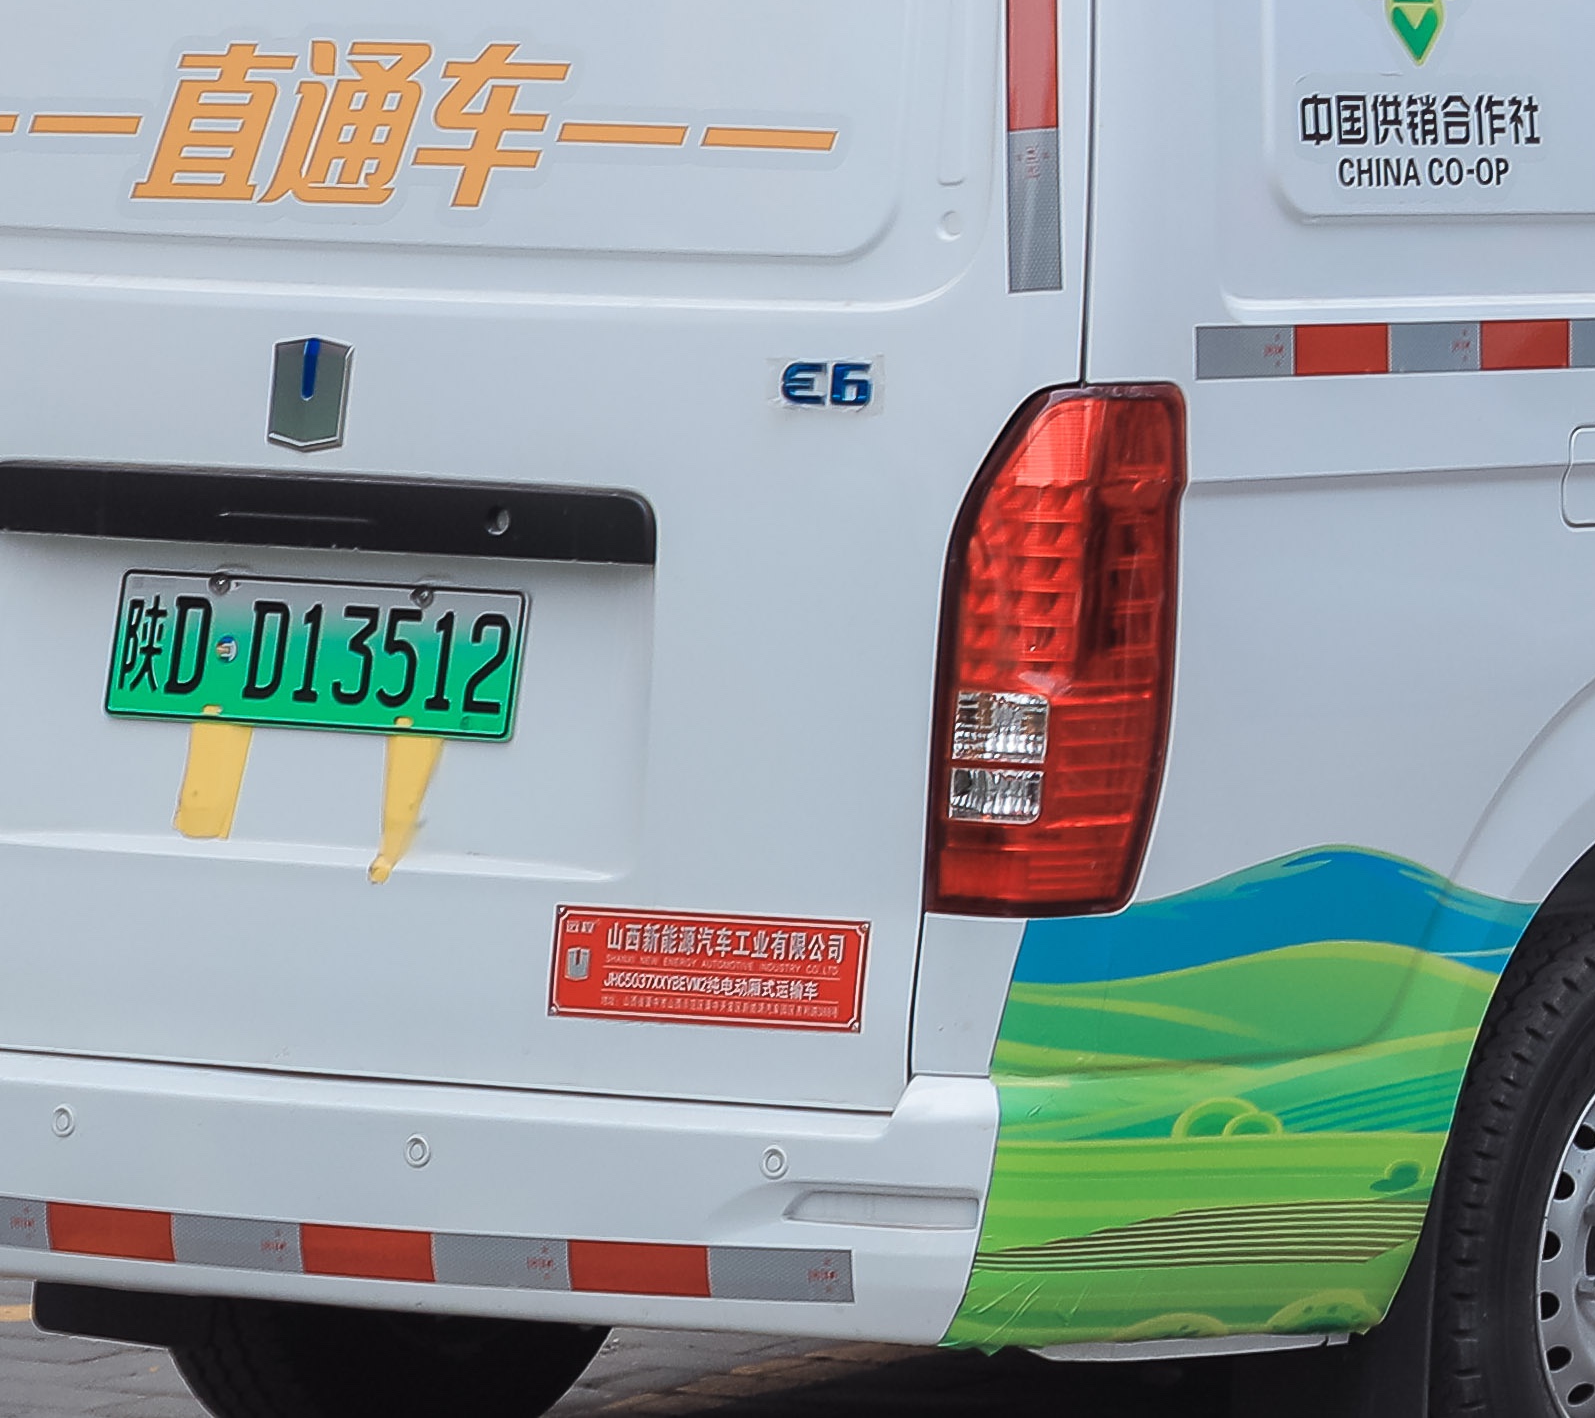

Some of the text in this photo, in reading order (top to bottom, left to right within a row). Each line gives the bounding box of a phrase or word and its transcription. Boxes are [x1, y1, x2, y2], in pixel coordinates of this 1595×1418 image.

[1299, 93, 1541, 146] 中国供销合作社
[1337, 156, 1510, 188] CHINA CO-OP
[606, 922, 846, 964] 山西新能源汽车工业有限公司
